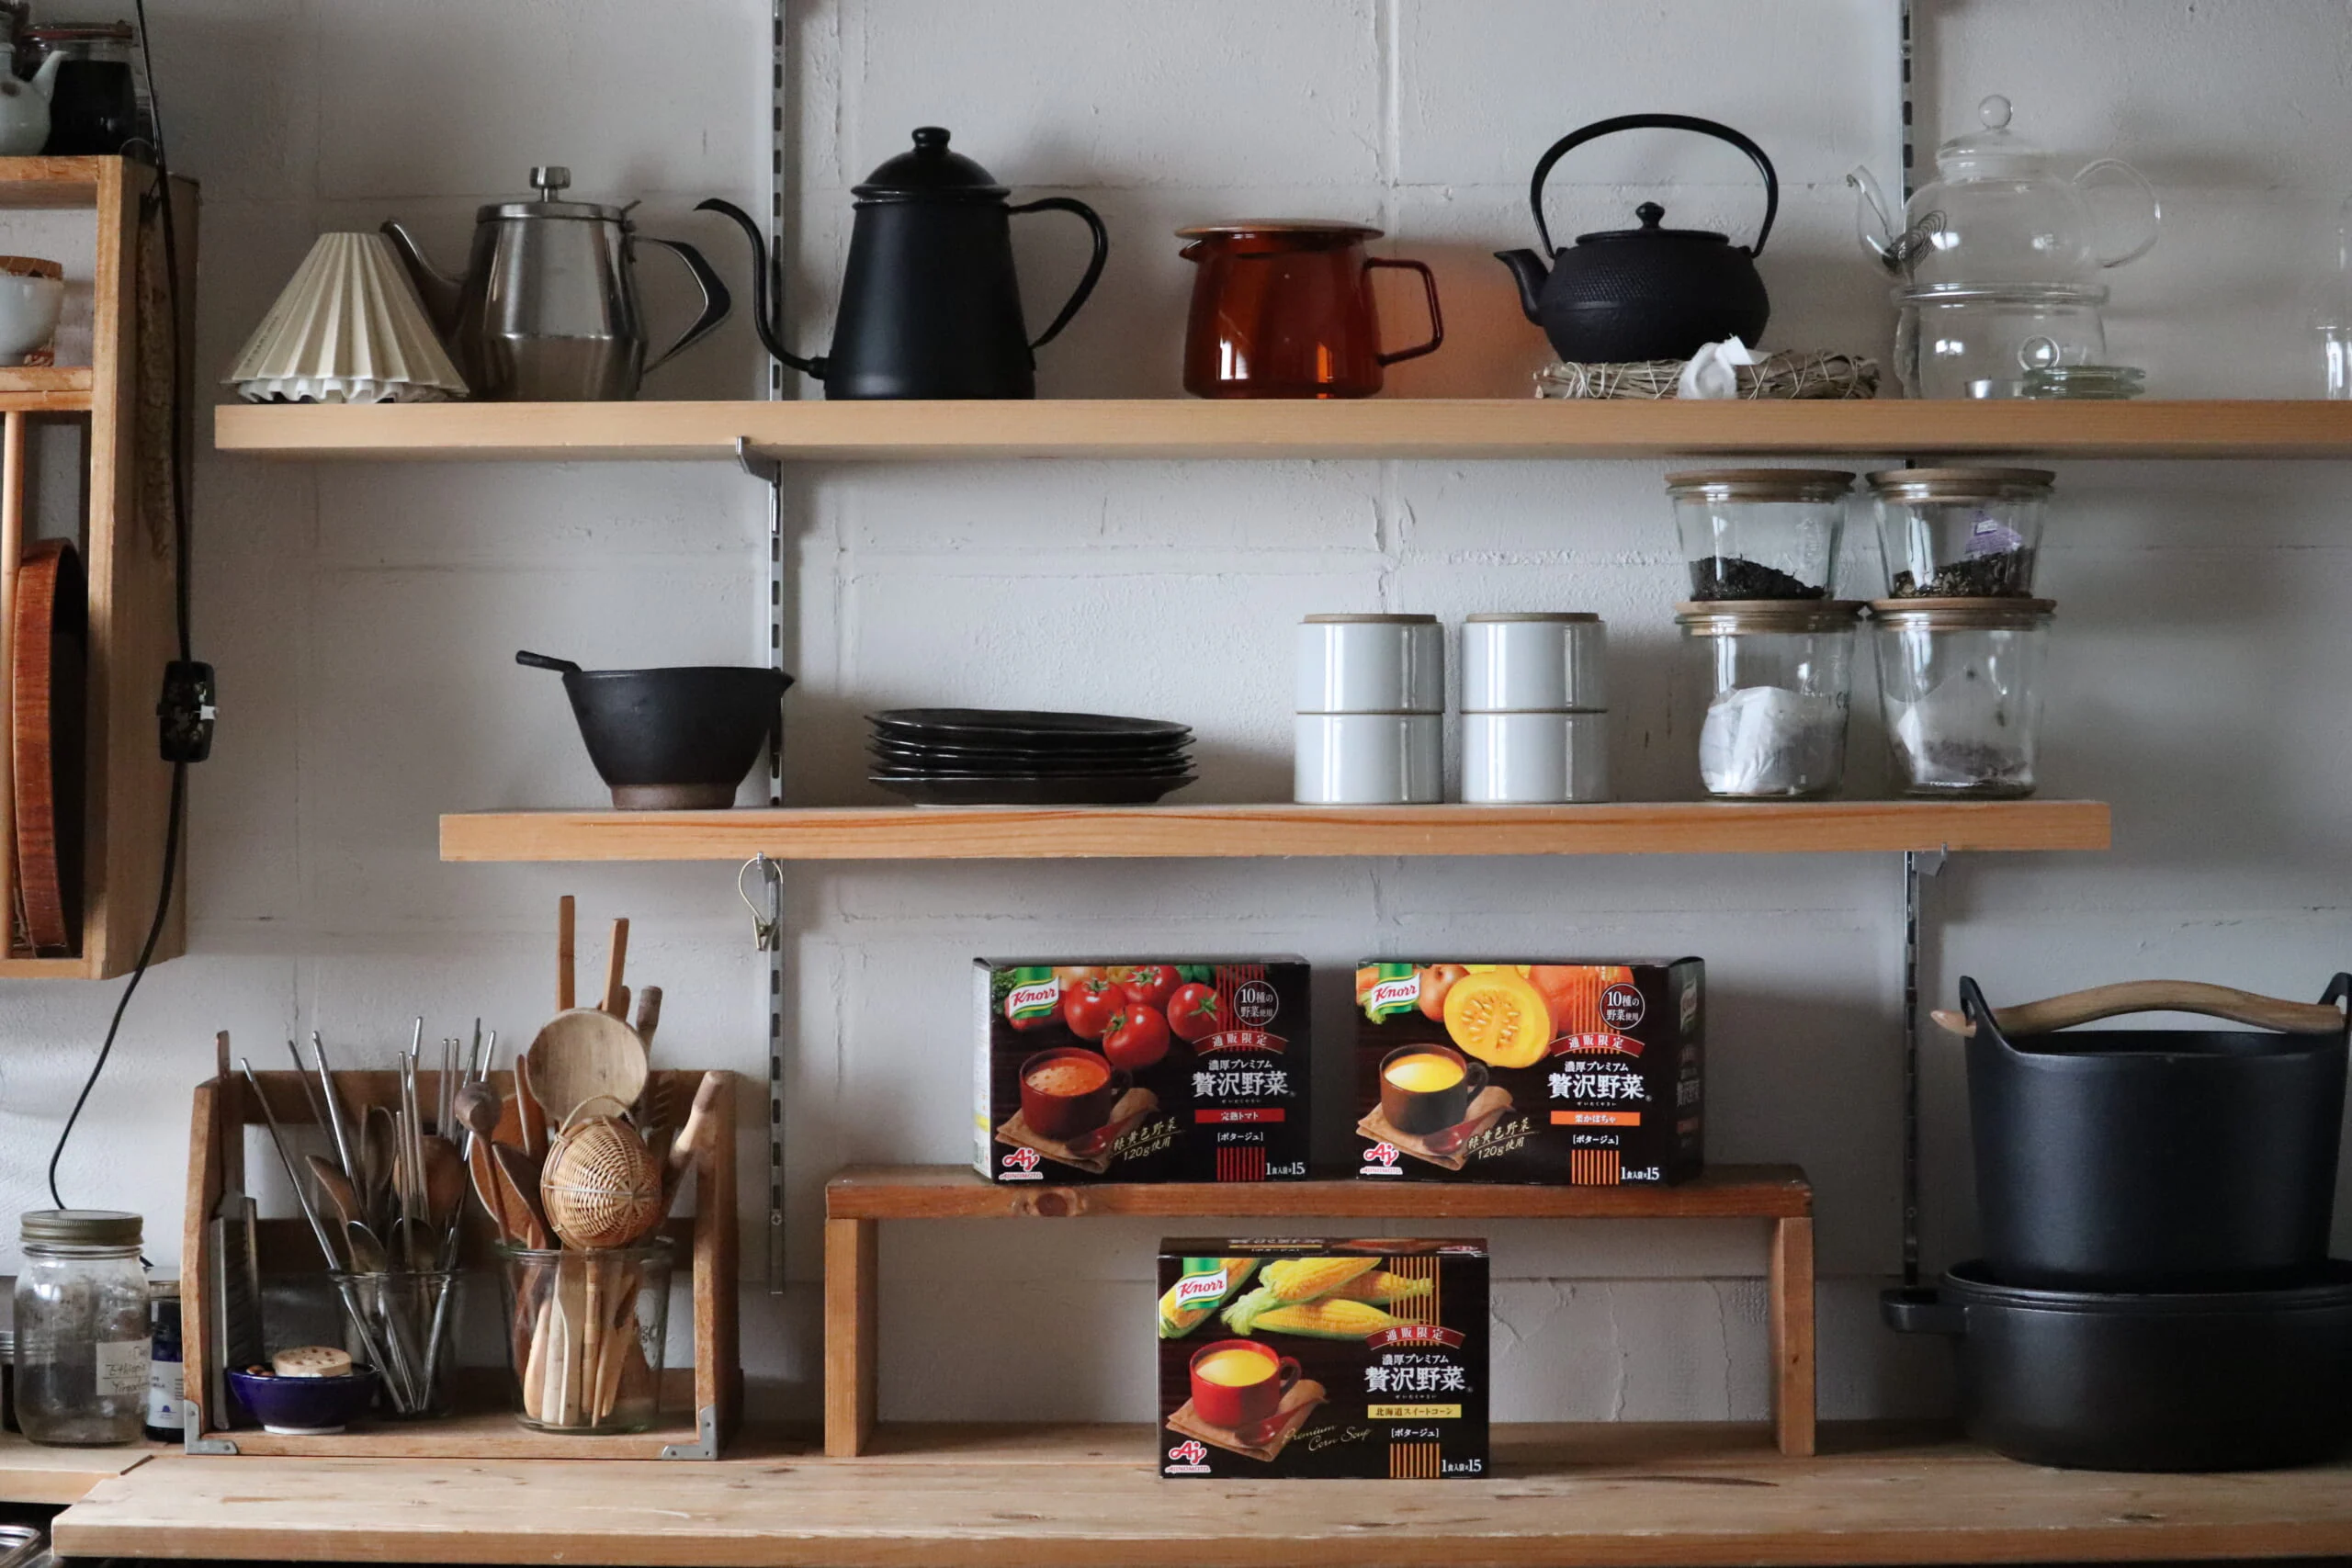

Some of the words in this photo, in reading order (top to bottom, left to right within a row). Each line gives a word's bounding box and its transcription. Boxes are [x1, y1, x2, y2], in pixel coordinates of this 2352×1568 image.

[1012, 988, 1056, 1007] Knorr
[1240, 987, 1273, 1003] 10種の
[1374, 985, 1417, 1002] Knorr
[1607, 991, 1639, 1007] 10種の
[1240, 1006, 1272, 1018] 野菜使用
[1606, 1009, 1639, 1021] 野菜使用
[1213, 1032, 1267, 1047] 通販限定
[1568, 1034, 1624, 1049] 通販限定
[1208, 1059, 1272, 1071] 濃厚プレミアム
[1565, 1060, 1629, 1072] 濃厚プレミアム
[1192, 1071, 1289, 1098] 贅沢野菜
[1547, 1072, 1645, 1100] 贅沢野菜
[1221, 1111, 1259, 1121] 完熟トマト
[1468, 1117, 1531, 1149] 緑黄色野菜
[1179, 1280, 1224, 1298] Knorr
[1385, 1326, 1443, 1341] 通販限定
[1382, 1353, 1449, 1365] 濃厚プレミアム
[1364, 1366, 1465, 1393] 贅沢野菜
[1376, 1407, 1453, 1416] 北海道スイートコーン
